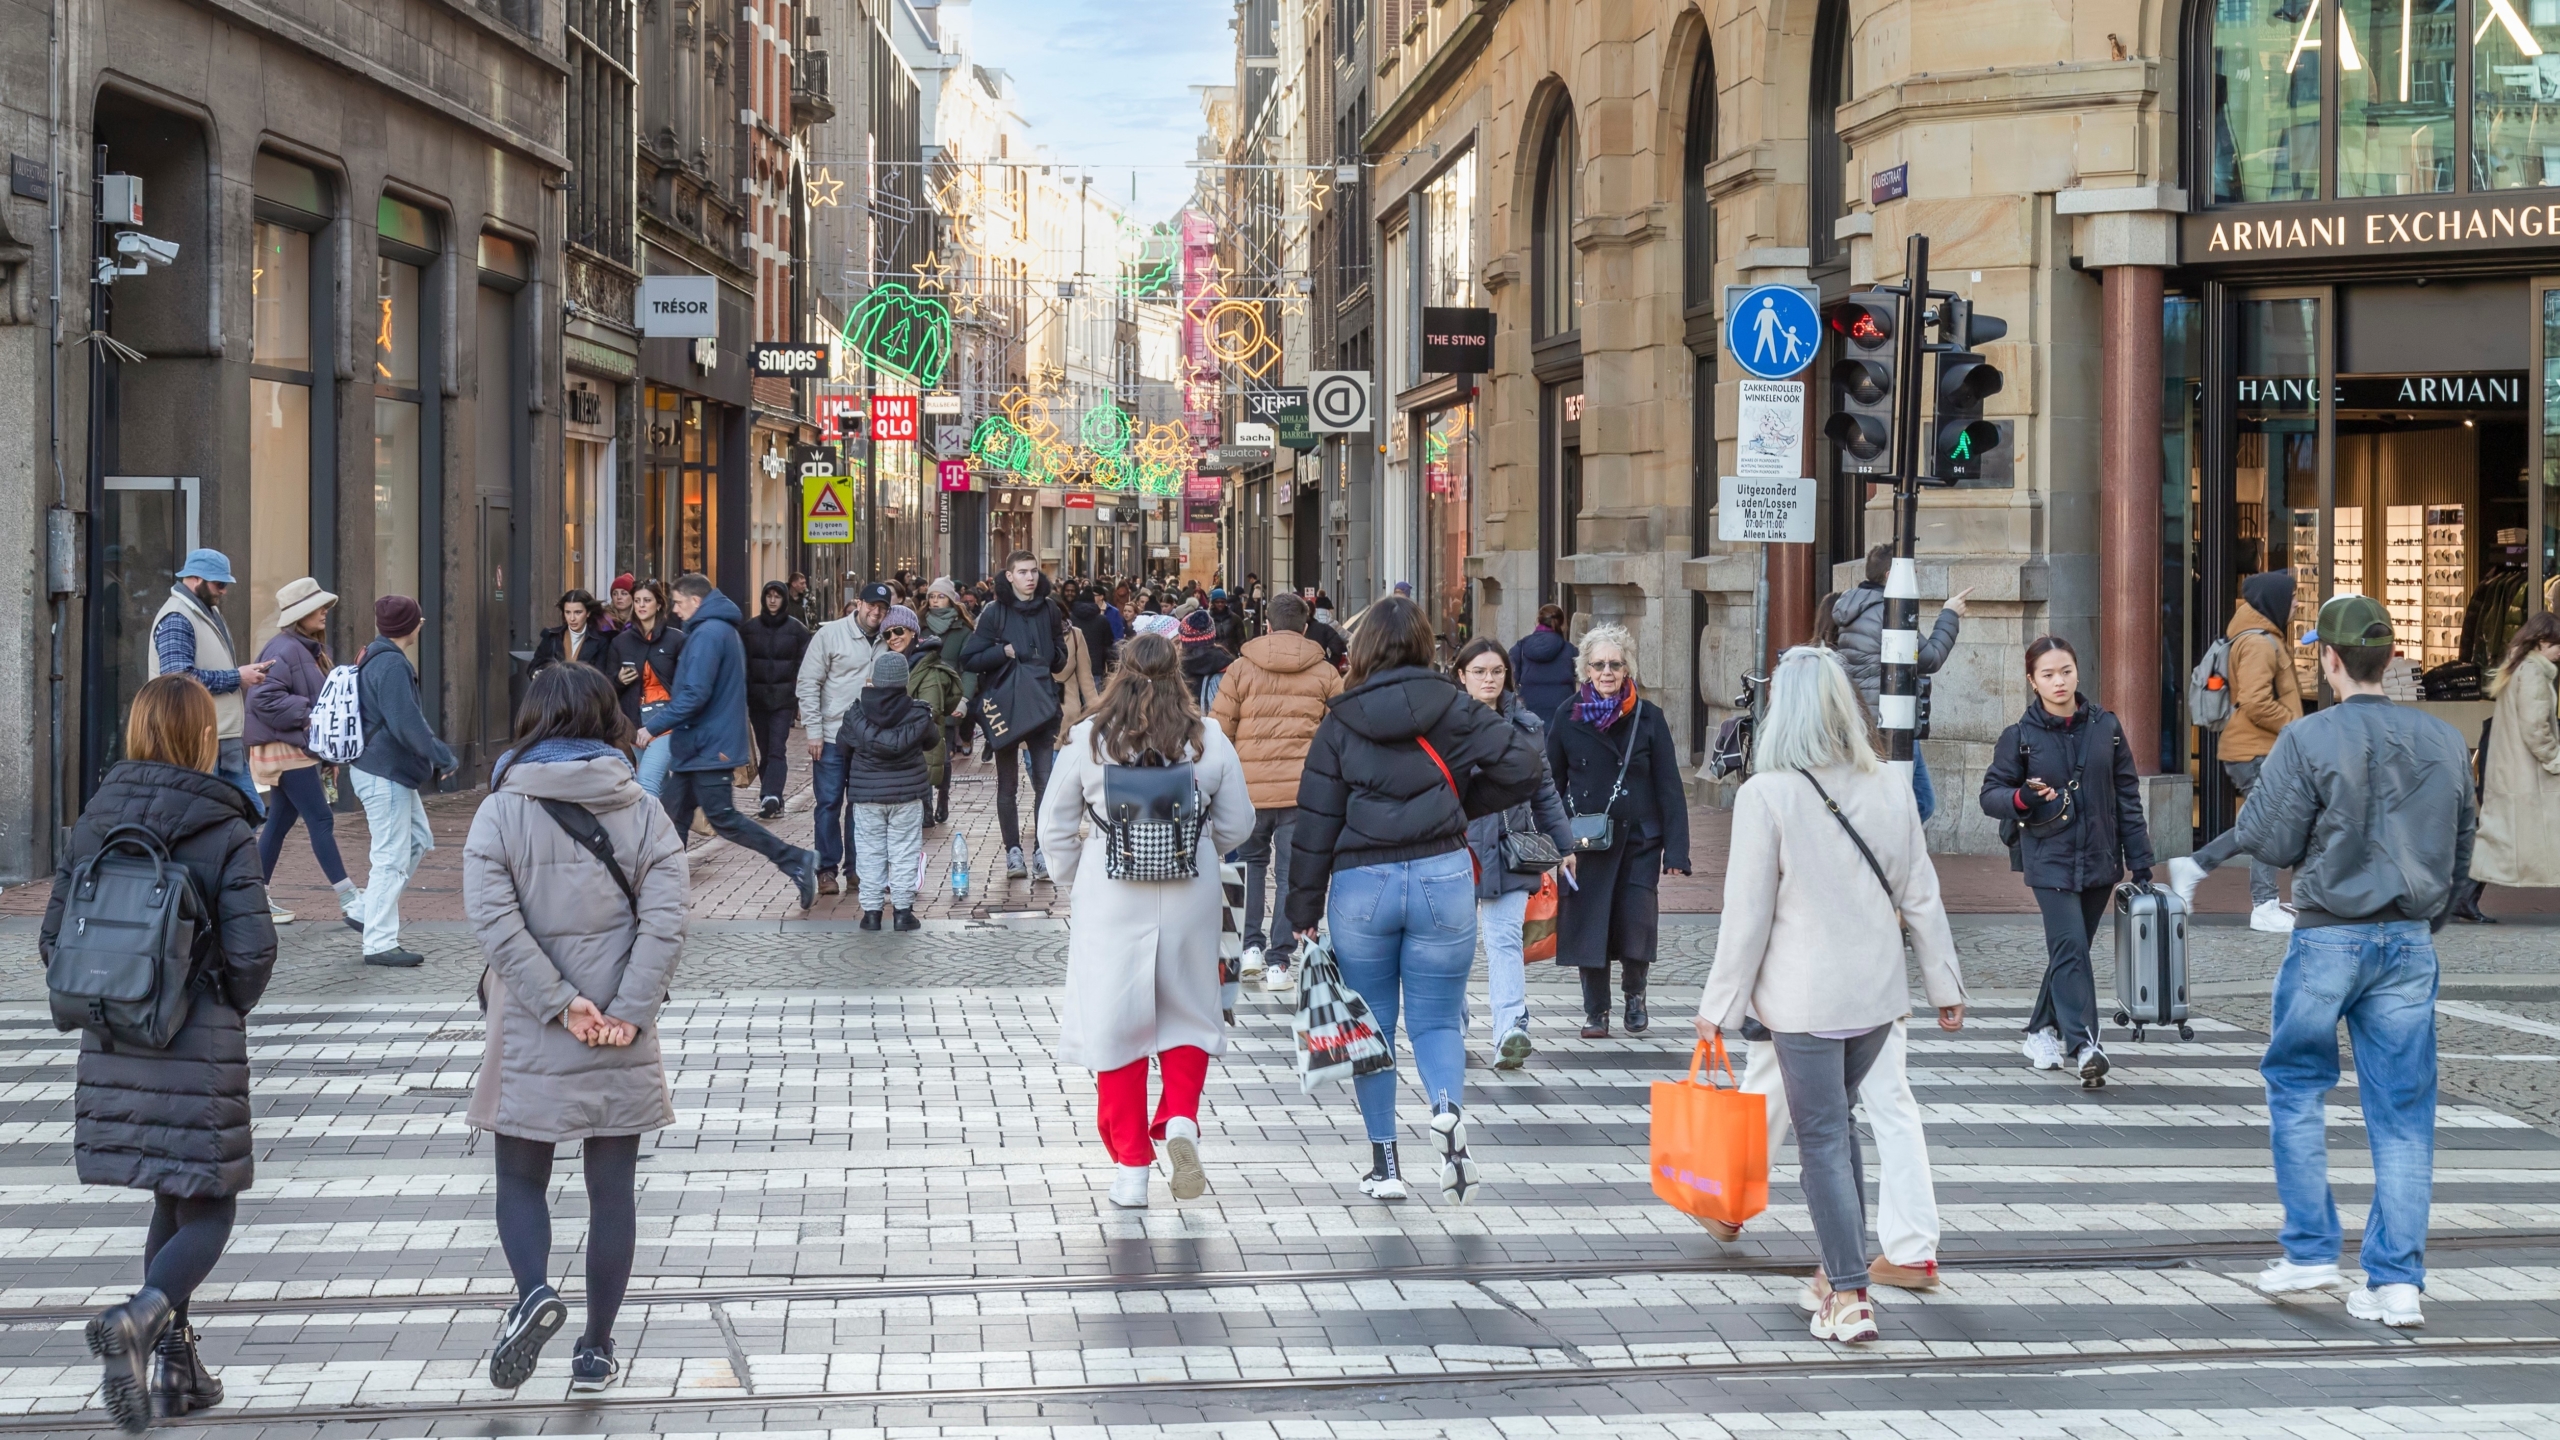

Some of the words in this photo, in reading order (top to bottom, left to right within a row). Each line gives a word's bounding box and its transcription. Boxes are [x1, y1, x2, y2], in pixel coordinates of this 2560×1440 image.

[1872, 168, 1902, 190] KALVERSTRAAT
[2208, 216, 2345, 252] ARMANI
[2366, 204, 2560, 244] EXCHANGE
[652, 297, 709, 314] TRÉSOR
[1427, 334, 1449, 345] THE
[1451, 335, 1486, 346] STING
[758, 349, 817, 375] snipes
[1743, 383, 1802, 393] ZAKKENROLLERS
[2397, 377, 2520, 402] ARMANI
[1745, 394, 1782, 402] WINKELEN
[876, 400, 909, 417] UNI
[1280, 415, 1309, 423] HOLLAN
[876, 419, 912, 438] QLO
[1239, 433, 1271, 442] sacha
[1281, 431, 1314, 439] BARRETT
[1221, 448, 1262, 458] swatch
[1953, 466, 1965, 474] 941
[1737, 484, 1797, 497] Uitgezonderd
[940, 492, 948, 533] MANFIELD
[1744, 508, 1757, 519] Ma
[1760, 509, 1774, 519] t/m
[1777, 509, 1788, 520] Za
[815, 521, 823, 529] bij
[1743, 530, 1765, 539] Alleen
[1767, 530, 1787, 539] Links
